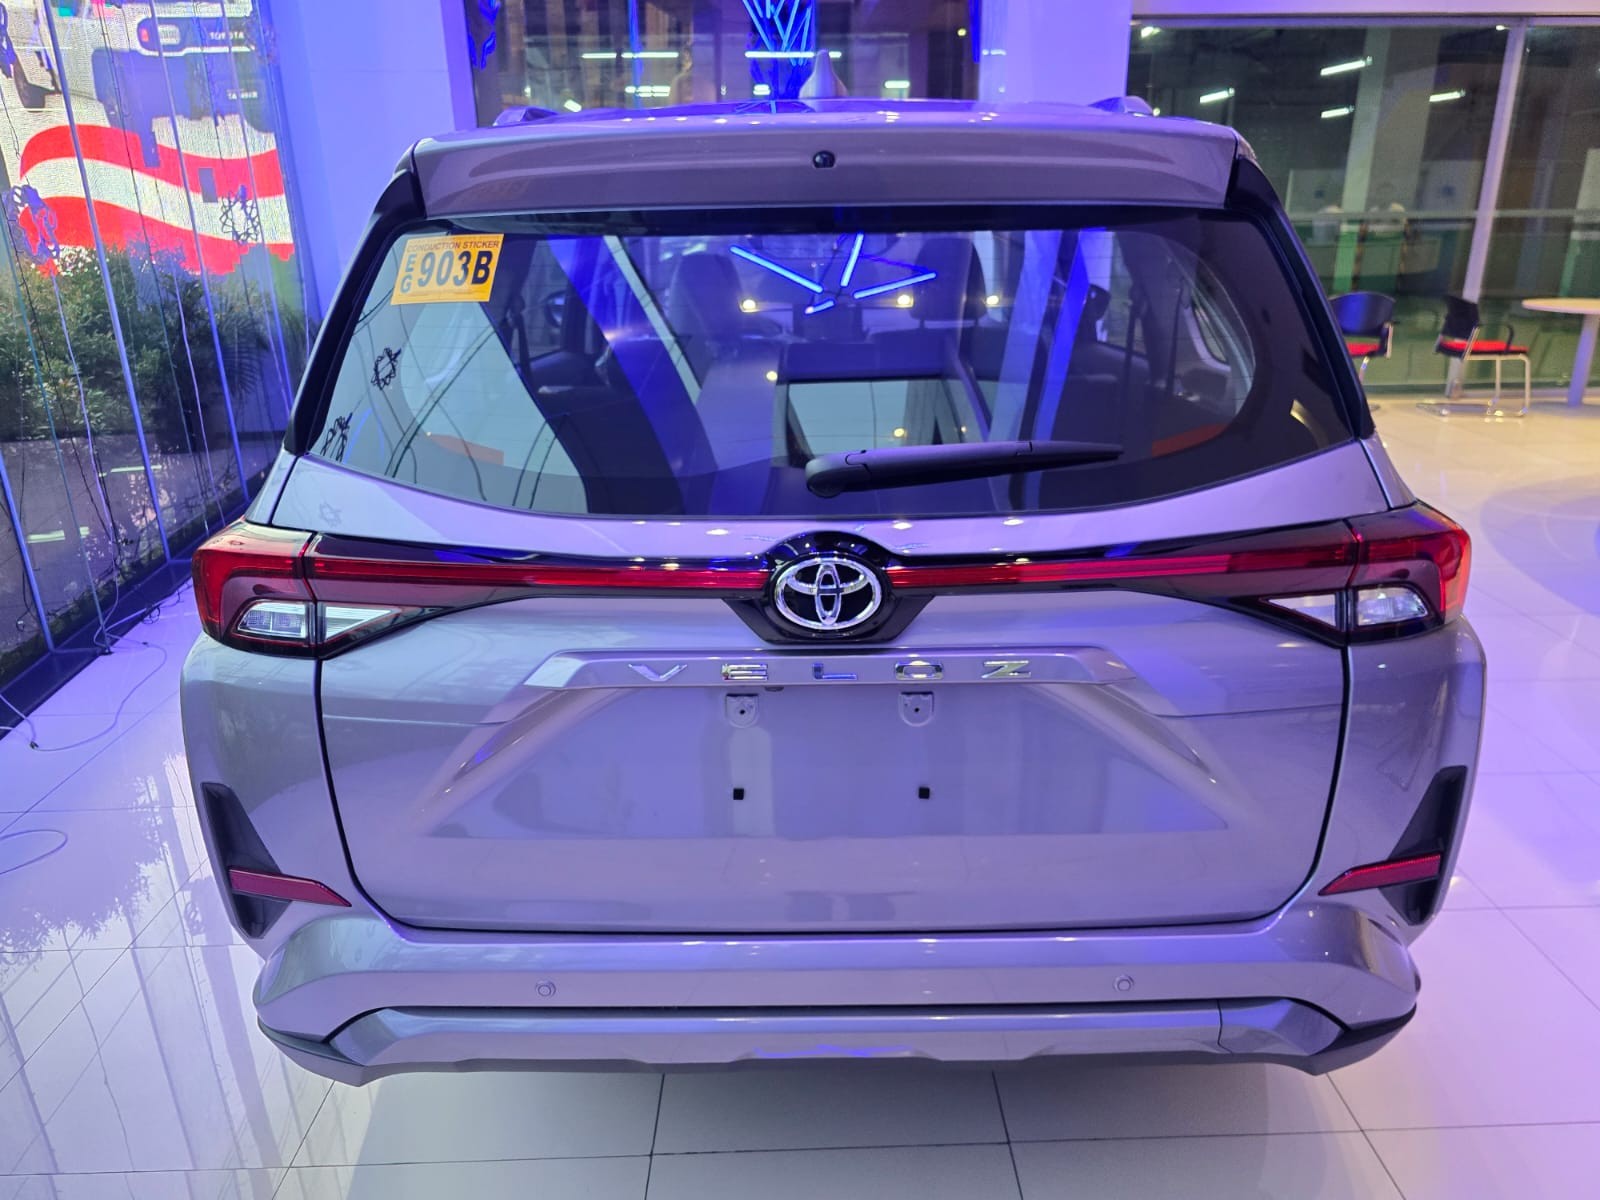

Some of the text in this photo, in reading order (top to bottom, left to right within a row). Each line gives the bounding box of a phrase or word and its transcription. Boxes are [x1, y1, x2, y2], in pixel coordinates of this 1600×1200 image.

[462, 240, 500, 250] STICKER
[417, 250, 493, 287] 903B
[628, 660, 1032, 681] VELOZ
